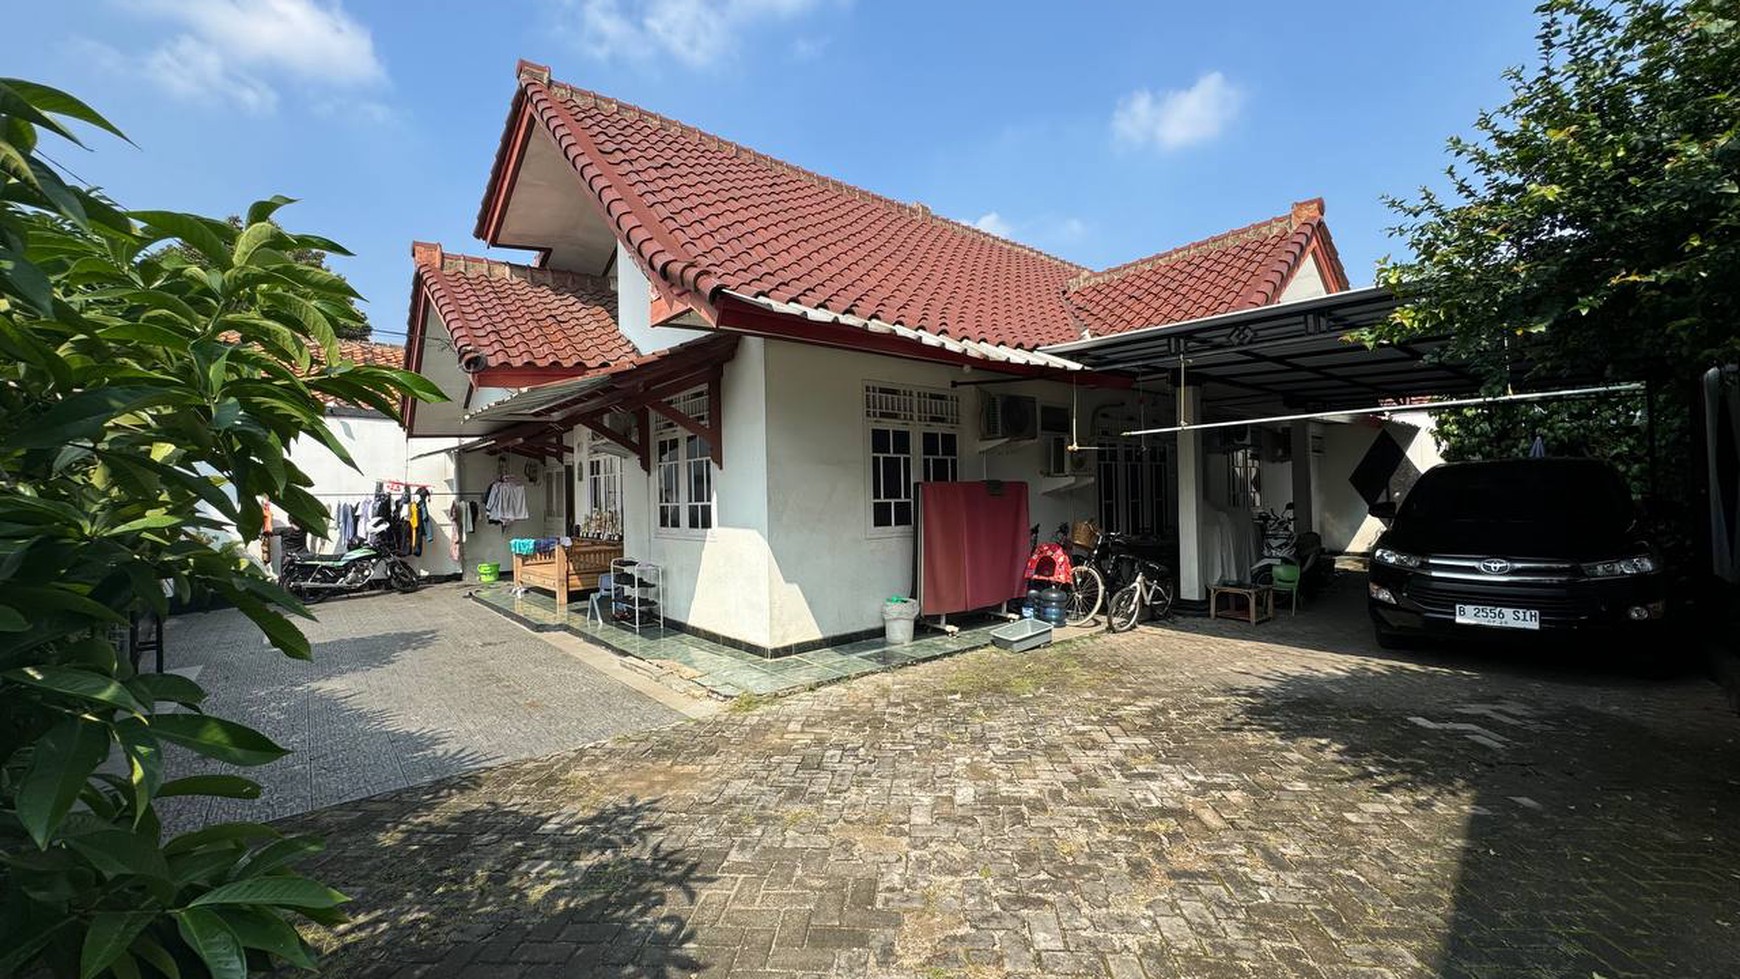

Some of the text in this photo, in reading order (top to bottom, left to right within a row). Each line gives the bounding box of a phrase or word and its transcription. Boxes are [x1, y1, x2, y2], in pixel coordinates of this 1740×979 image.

[1458, 606, 1466, 616] B
[1473, 607, 1505, 619] 2556
[1512, 610, 1537, 622] SIH
